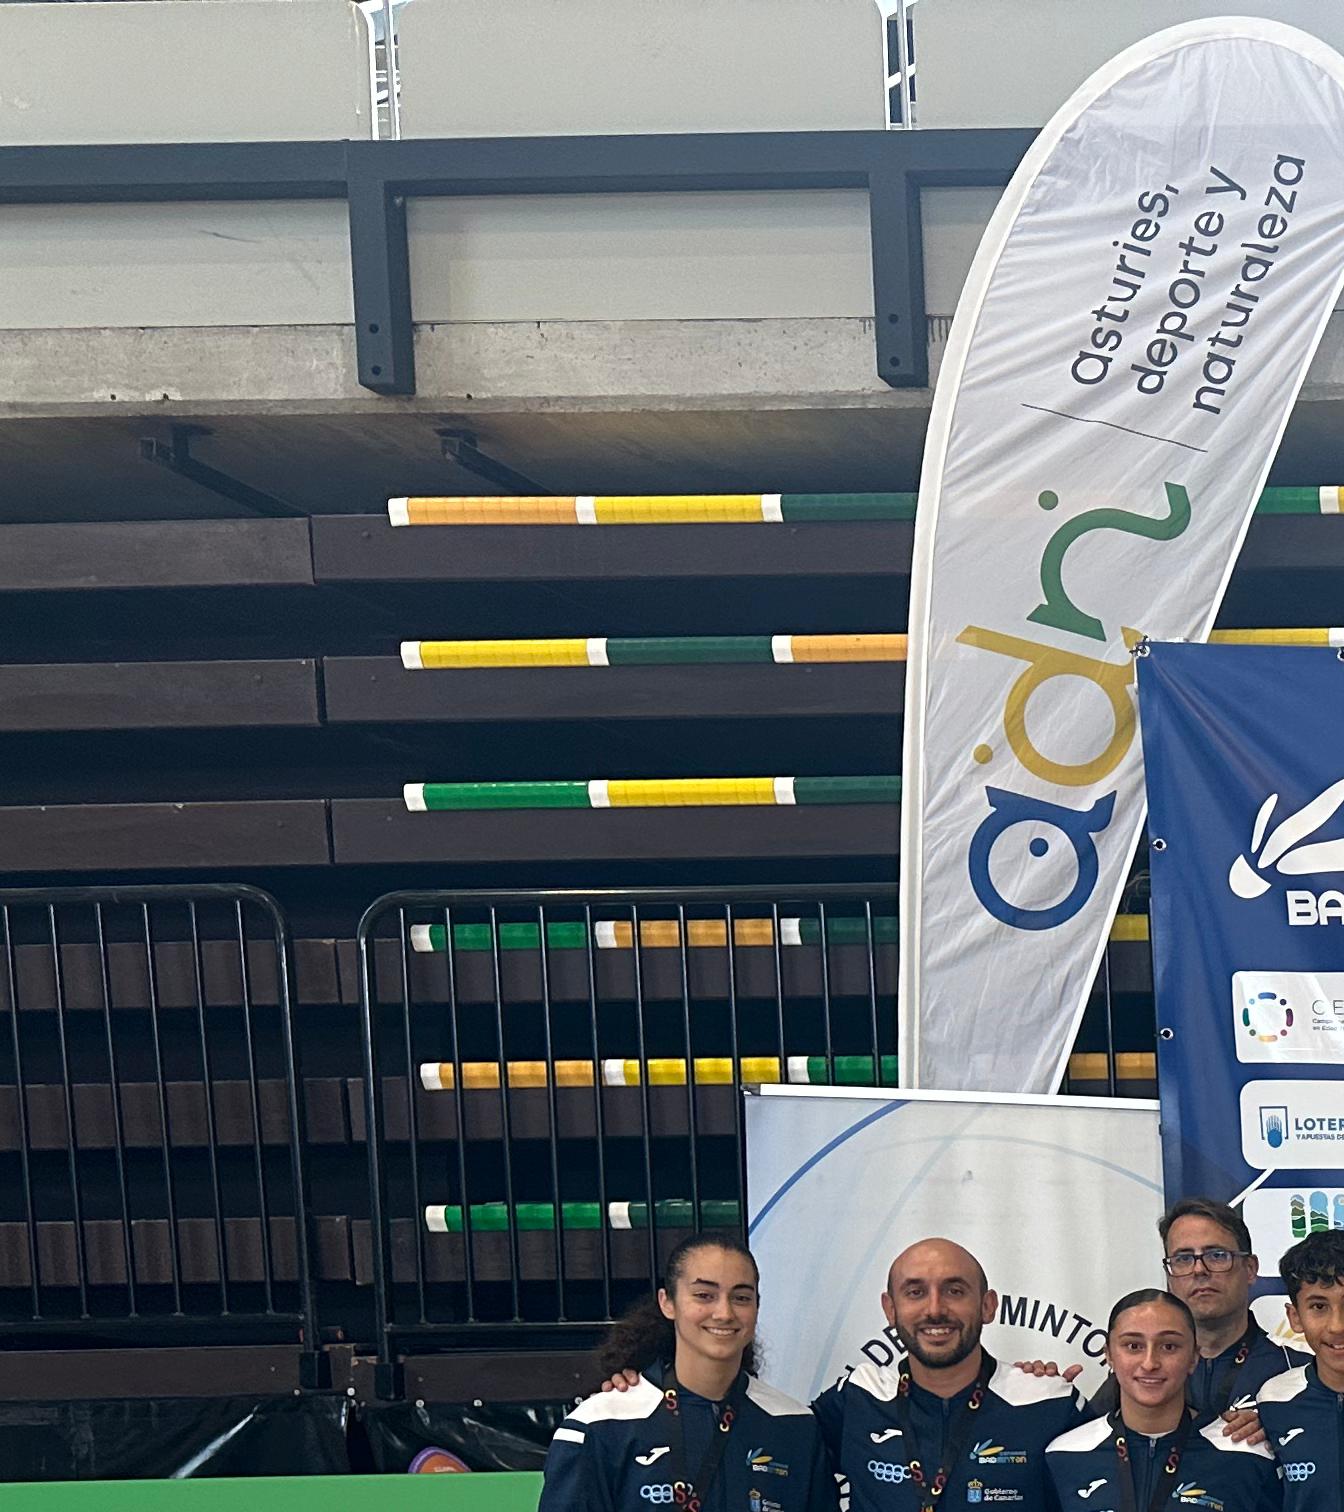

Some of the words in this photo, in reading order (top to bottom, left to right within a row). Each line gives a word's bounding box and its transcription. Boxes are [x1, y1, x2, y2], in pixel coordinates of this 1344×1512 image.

[1071, 179, 1181, 386] asturies,
[1131, 210, 1225, 397] deporte
[1205, 166, 1248, 201] y
[1191, 153, 1307, 415] naturaleza
